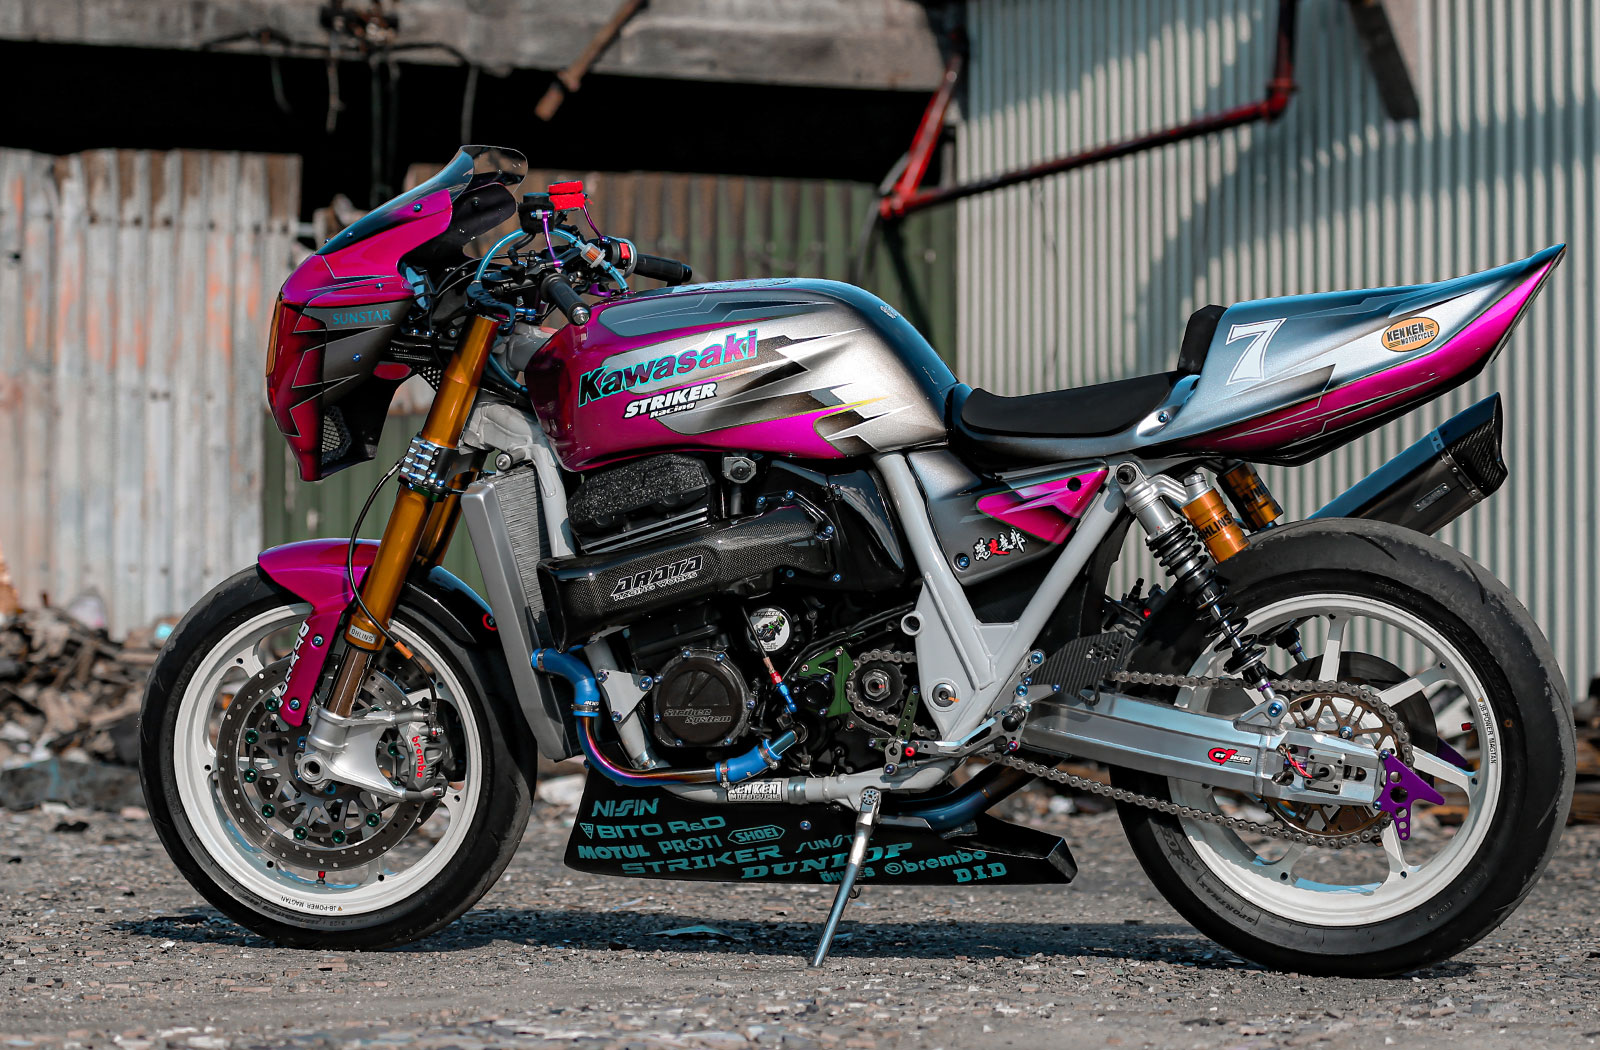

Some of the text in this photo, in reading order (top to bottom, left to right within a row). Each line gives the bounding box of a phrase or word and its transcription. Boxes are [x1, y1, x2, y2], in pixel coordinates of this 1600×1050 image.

[332, 309, 392, 325] SUNSTAR
[1386, 322, 1424, 342] KEN KEN
[1401, 330, 1435, 345] MOTORCYCLE
[1225, 318, 1288, 386] 7
[578, 328, 758, 407] Kawasaki
[624, 383, 717, 419] STRIKER
[650, 402, 695, 418] Racing
[609, 555, 703, 597] ARATA
[411, 735, 427, 778] brembo
[597, 822, 664, 839] BITO
[667, 815, 726, 834] R&D
[734, 827, 779, 842] SHOEI
[578, 845, 650, 859] MOTUL
[657, 834, 723, 855] PROTI
[795, 834, 874, 854] SUNST
[621, 844, 784, 874] STRIKER
[901, 849, 988, 873] brembo
[952, 862, 1008, 883] D.I.D
